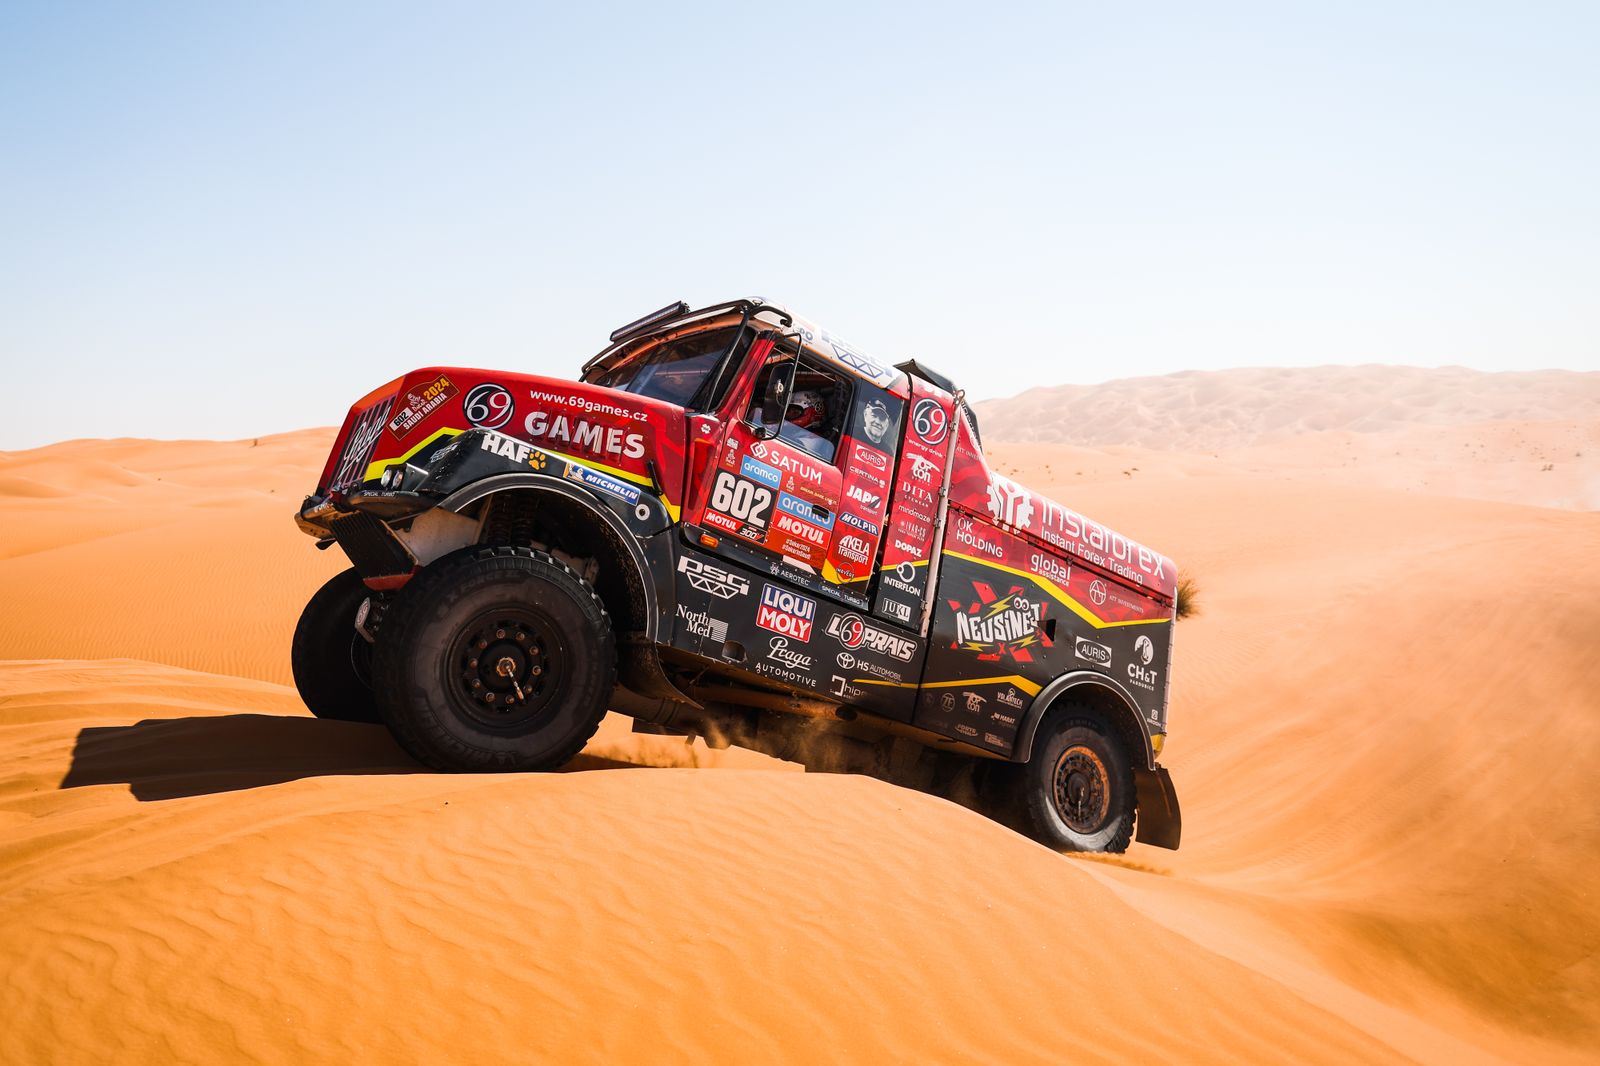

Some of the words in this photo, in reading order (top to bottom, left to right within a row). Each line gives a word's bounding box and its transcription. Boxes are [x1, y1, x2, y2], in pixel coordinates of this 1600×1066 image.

[424, 378, 449, 400] 2024
[403, 411, 424, 430] SAUDI
[422, 393, 447, 414] ARABIA
[464, 385, 514, 427] 69
[530, 390, 648, 422] www.69games.cz
[394, 411, 409, 426] 602
[913, 398, 949, 445] 69
[524, 411, 646, 458] GAMES
[481, 433, 528, 464] HAF
[860, 450, 882, 466] AURIS
[744, 462, 779, 483] aramco
[769, 450, 823, 485] SATUM
[849, 466, 879, 483] CERTINA
[586, 473, 638, 500] MICHELIN
[846, 485, 881, 509] JAPO
[903, 481, 933, 504] DITA
[711, 472, 772, 527] 602
[705, 512, 737, 530] MOTUL
[841, 513, 878, 534] MOLPIR
[899, 505, 931, 523] mindmaze
[777, 516, 824, 545] MOTUL
[1038, 498, 1165, 580] instaforex
[838, 546, 869, 565] Transport
[839, 535, 870, 556] AKELA
[895, 539, 922, 558] DOPAZ
[956, 532, 1003, 558] HOLDING
[1041, 525, 1075, 553] Instant
[1077, 542, 1106, 567] Forex
[1108, 557, 1143, 587] Trading
[780, 569, 810, 586] AEROTEC
[1031, 553, 1071, 580] global
[1038, 568, 1069, 587] assistance
[821, 585, 841, 597] SPECIAL
[884, 575, 921, 597] INTERFLON
[763, 586, 814, 620] LIQUI
[675, 603, 710, 627] North
[758, 607, 811, 643] MOLY
[686, 620, 711, 638] Med
[767, 636, 812, 671] Praga
[1081, 644, 1106, 661] AURIS
[755, 661, 817, 688] AUTOMOTIVE
[857, 659, 870, 671] HS
[1127, 663, 1157, 685] CH&T
[1129, 679, 1154, 692] PARDUBICE
